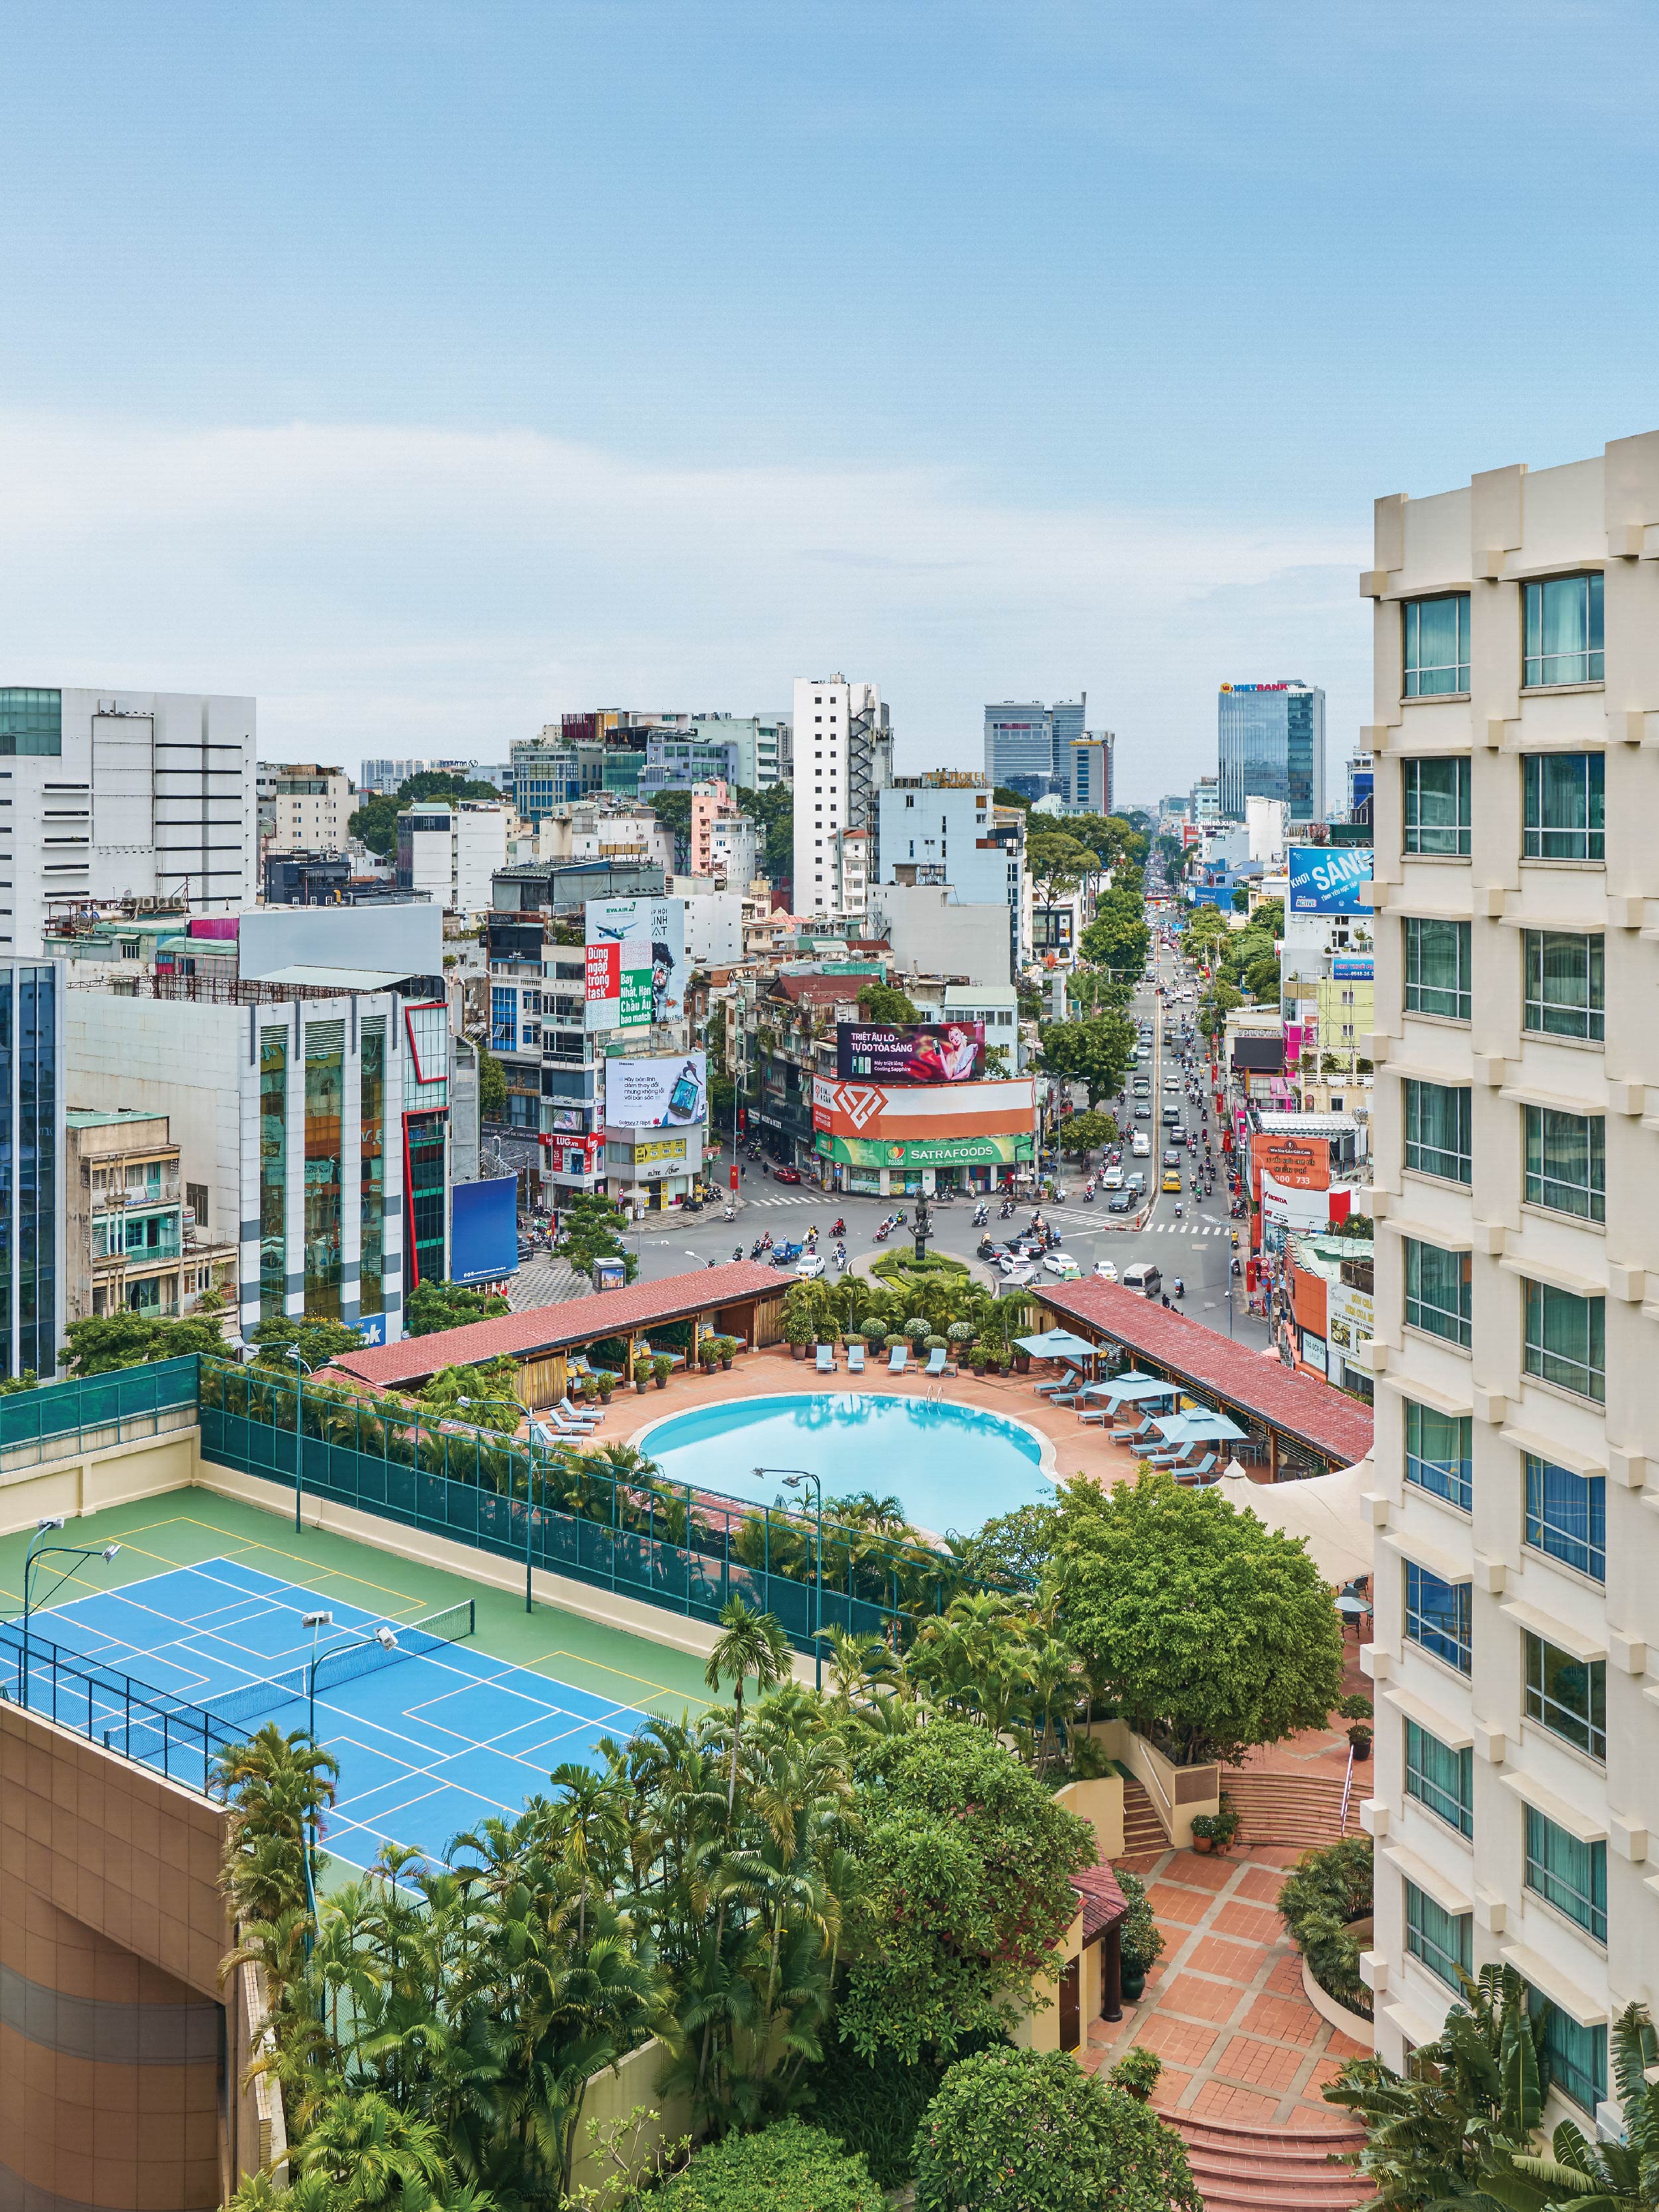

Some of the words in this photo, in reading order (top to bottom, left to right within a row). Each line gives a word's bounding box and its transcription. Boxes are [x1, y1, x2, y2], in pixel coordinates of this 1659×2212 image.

[950, 772, 985, 781] HOTEL
[1311, 849, 1371, 891] SÁNG
[651, 916, 668, 926] INH
[588, 946, 609, 962] Đừng
[587, 959, 608, 976] ngập
[587, 974, 610, 988] trong
[620, 974, 634, 987] Bay
[587, 986, 606, 999] task
[639, 986, 651, 997] Hàn
[620, 999, 640, 1013] Châu
[642, 996, 651, 1009] Âu
[620, 1014, 632, 1025] bao
[632, 1011, 651, 1023] match
[851, 1032, 872, 1043] TRIỆT
[871, 1031, 883, 1041] ÂU
[851, 1042, 862, 1053] TỰ
[890, 1041, 912, 1052] SÁNG
[556, 1136, 579, 1147] LUG.vn
[587, 1136, 598, 1152] lug
[910, 1146, 993, 1159] SATRAFOODS
[1268, 1193, 1288, 1205] HONDA
